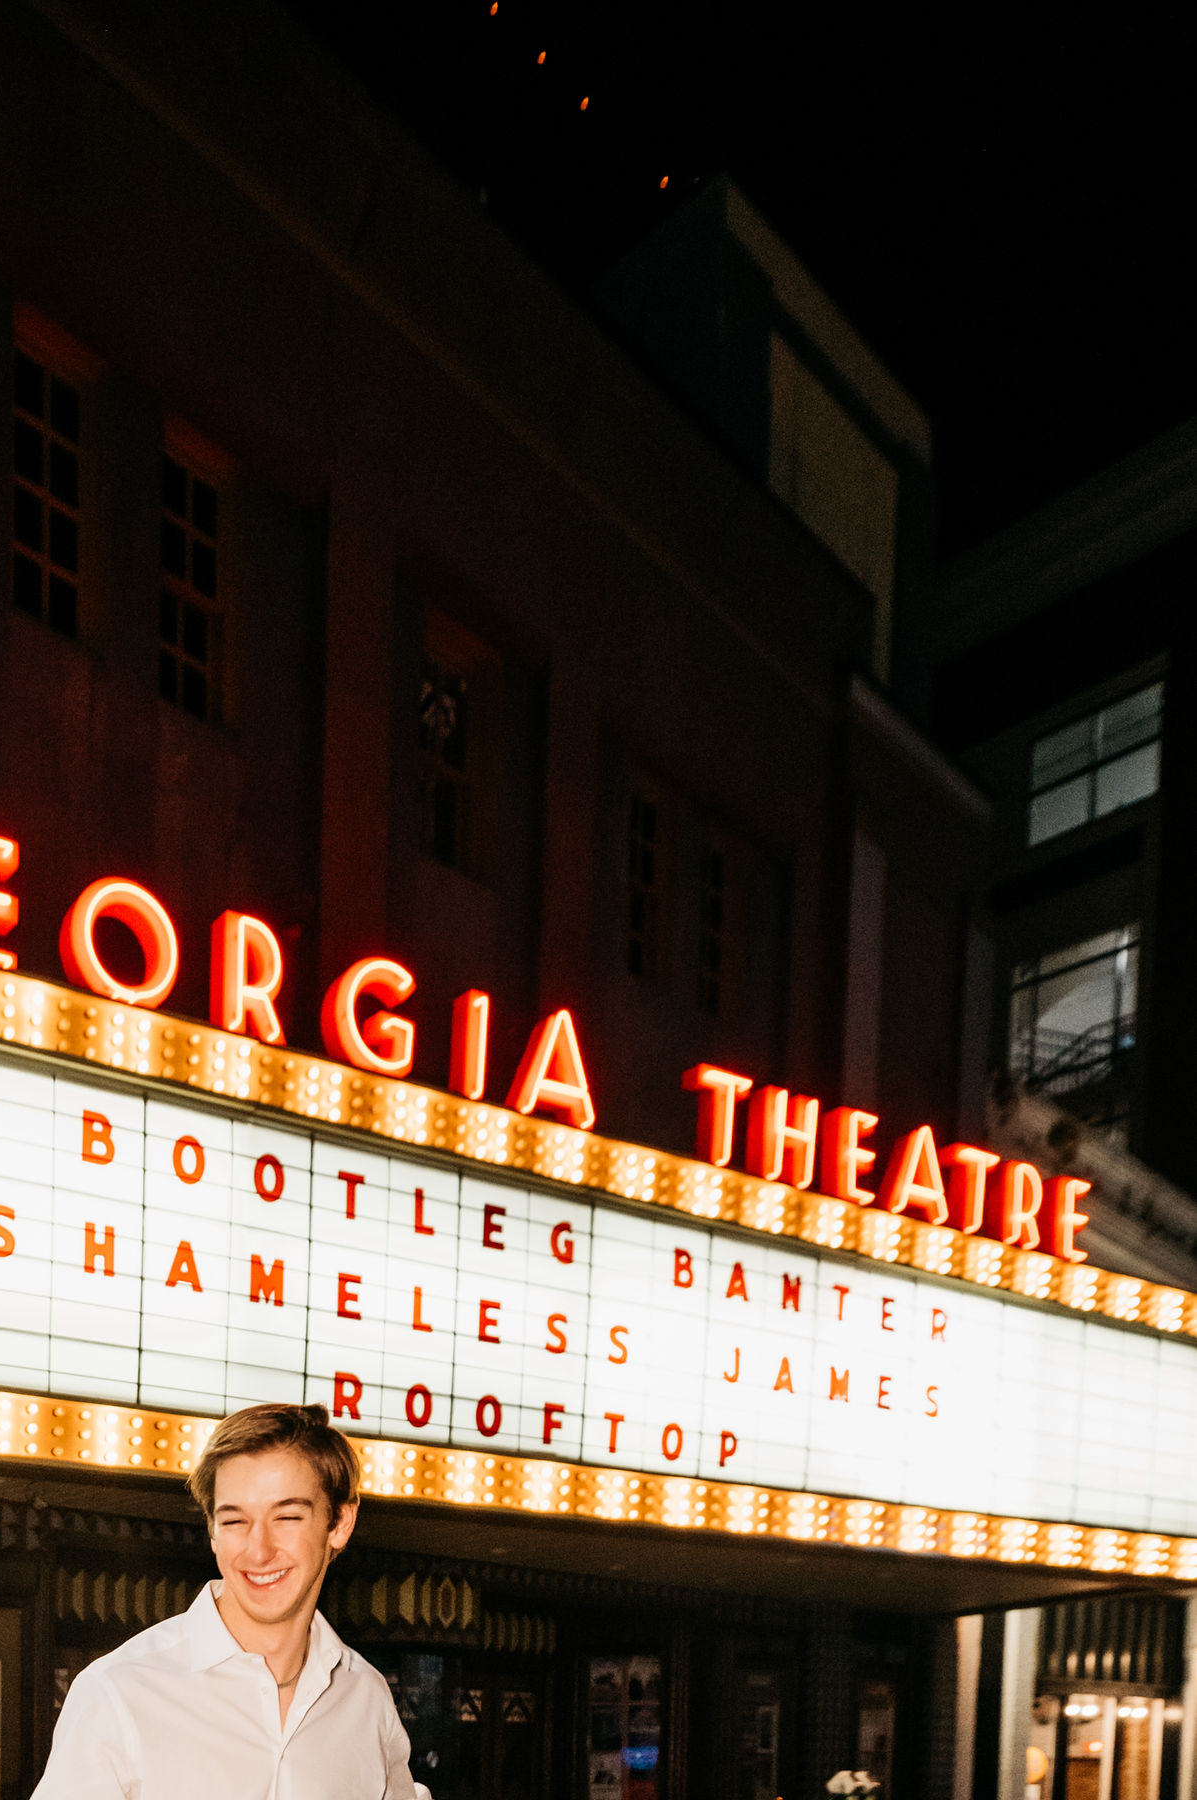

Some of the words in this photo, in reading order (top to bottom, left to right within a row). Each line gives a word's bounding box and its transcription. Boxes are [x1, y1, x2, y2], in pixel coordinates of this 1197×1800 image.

[81, 1108, 575, 1265] BOOTLEG
[673, 1248, 948, 1343] BANTER
[682, 1063, 1092, 1264] THEATRE
[332, 1371, 739, 1468] ROOFTOP
[722, 1346, 939, 1418] JAMES
